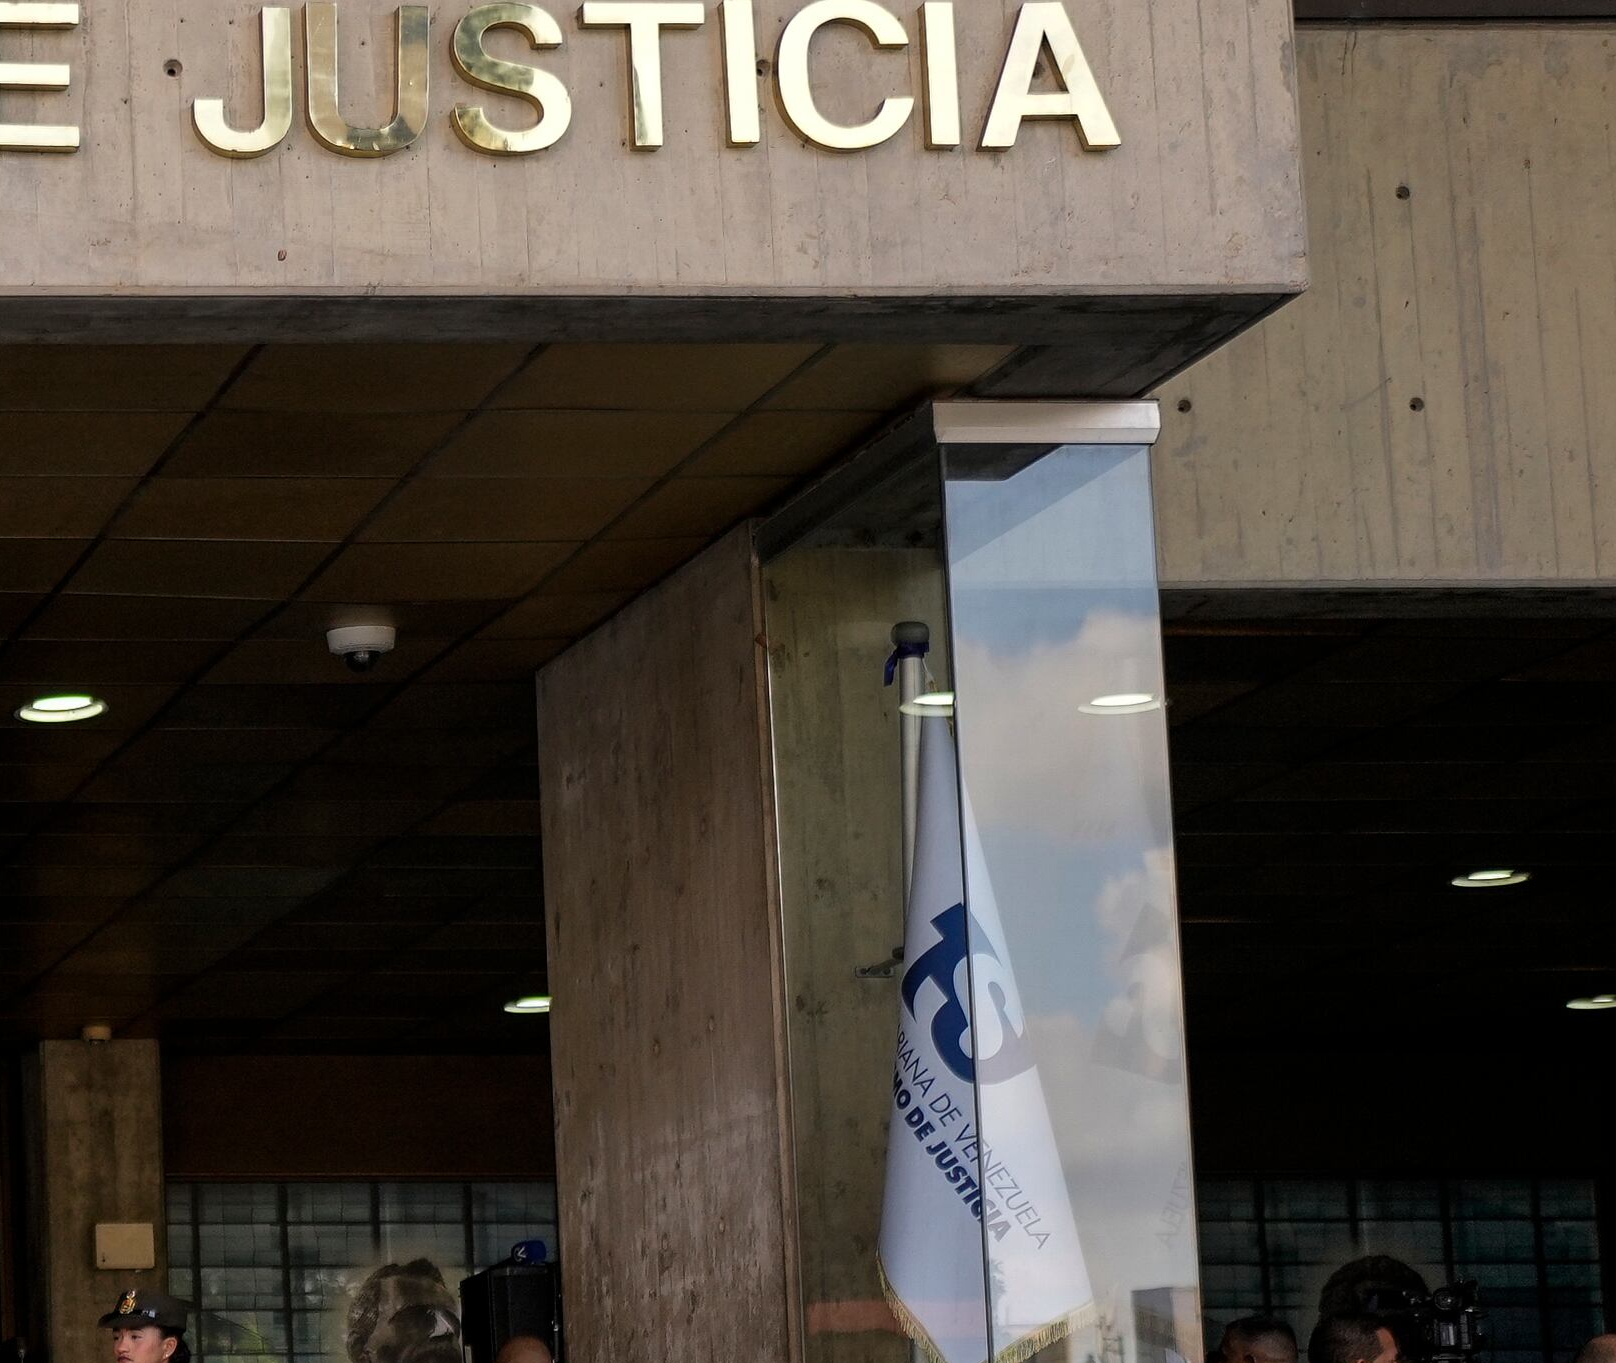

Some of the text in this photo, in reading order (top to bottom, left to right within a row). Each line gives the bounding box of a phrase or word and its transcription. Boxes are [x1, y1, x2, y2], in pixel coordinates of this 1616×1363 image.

[189, 1, 1124, 158] JUSTICIA
[905, 1106, 1013, 1242] DE JUSTICIA
[929, 1093, 963, 1127] DE
[954, 1123, 1052, 1250] VENEZUELA
